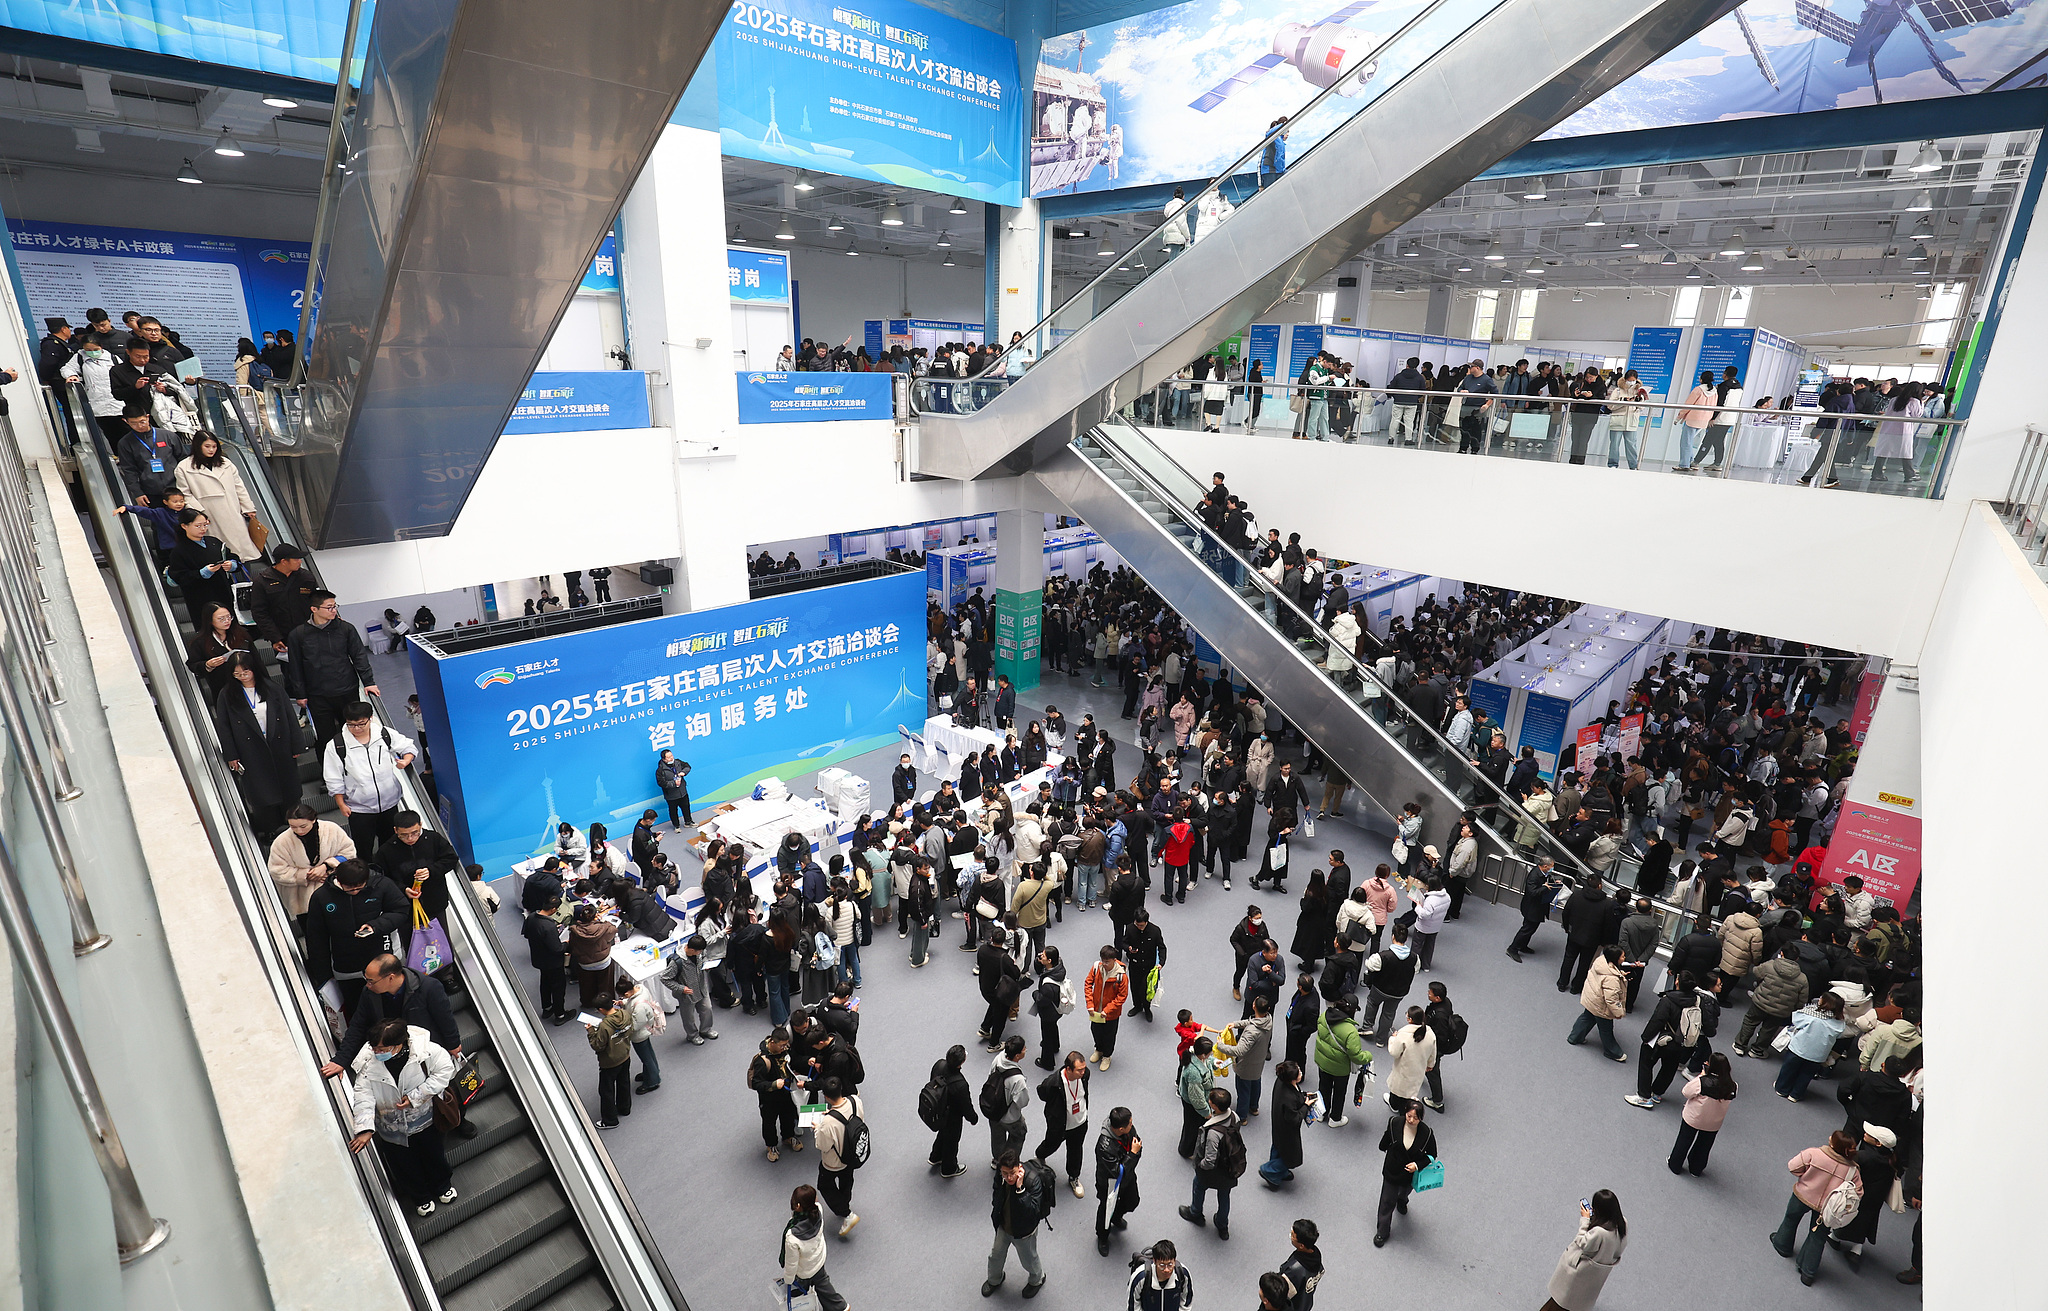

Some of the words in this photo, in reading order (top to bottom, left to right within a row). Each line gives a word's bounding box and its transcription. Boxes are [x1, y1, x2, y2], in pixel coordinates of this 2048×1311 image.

[733, 1, 1001, 100] 2025年石家庄高层次人才交流洽谈会
[736, 31, 759, 44] 2025
[762, 38, 829, 63] SHIJIAZHUANG
[833, 57, 883, 79] HIGH-LEVEL
[885, 72, 914, 87] TALENT
[917, 81, 955, 98] EXCHANGE
[957, 93, 1000, 112] CONFERENCE
[666, 632, 727, 658] 相聚新时代
[734, 619, 789, 644] 智汇石家庄
[1000, 614, 1014, 628] B区
[1023, 615, 1037, 628] B区
[506, 623, 900, 737] 2025年石家庄高层次人才交流洽谈会
[515, 657, 560, 674] 石家庄人才
[517, 671, 544, 680] Shijiazhuang
[513, 736, 547, 751] 2025
[554, 709, 655, 740] SHIJIAZHUANG
[660, 688, 733, 713] HIGH-LEVEL
[738, 676, 779, 692] TALENT
[784, 661, 836, 681] EXCHANGE
[840, 646, 899, 667] CONFERENCE
[648, 685, 808, 752] 咨询服务处
[1846, 848, 1899, 876] A区
